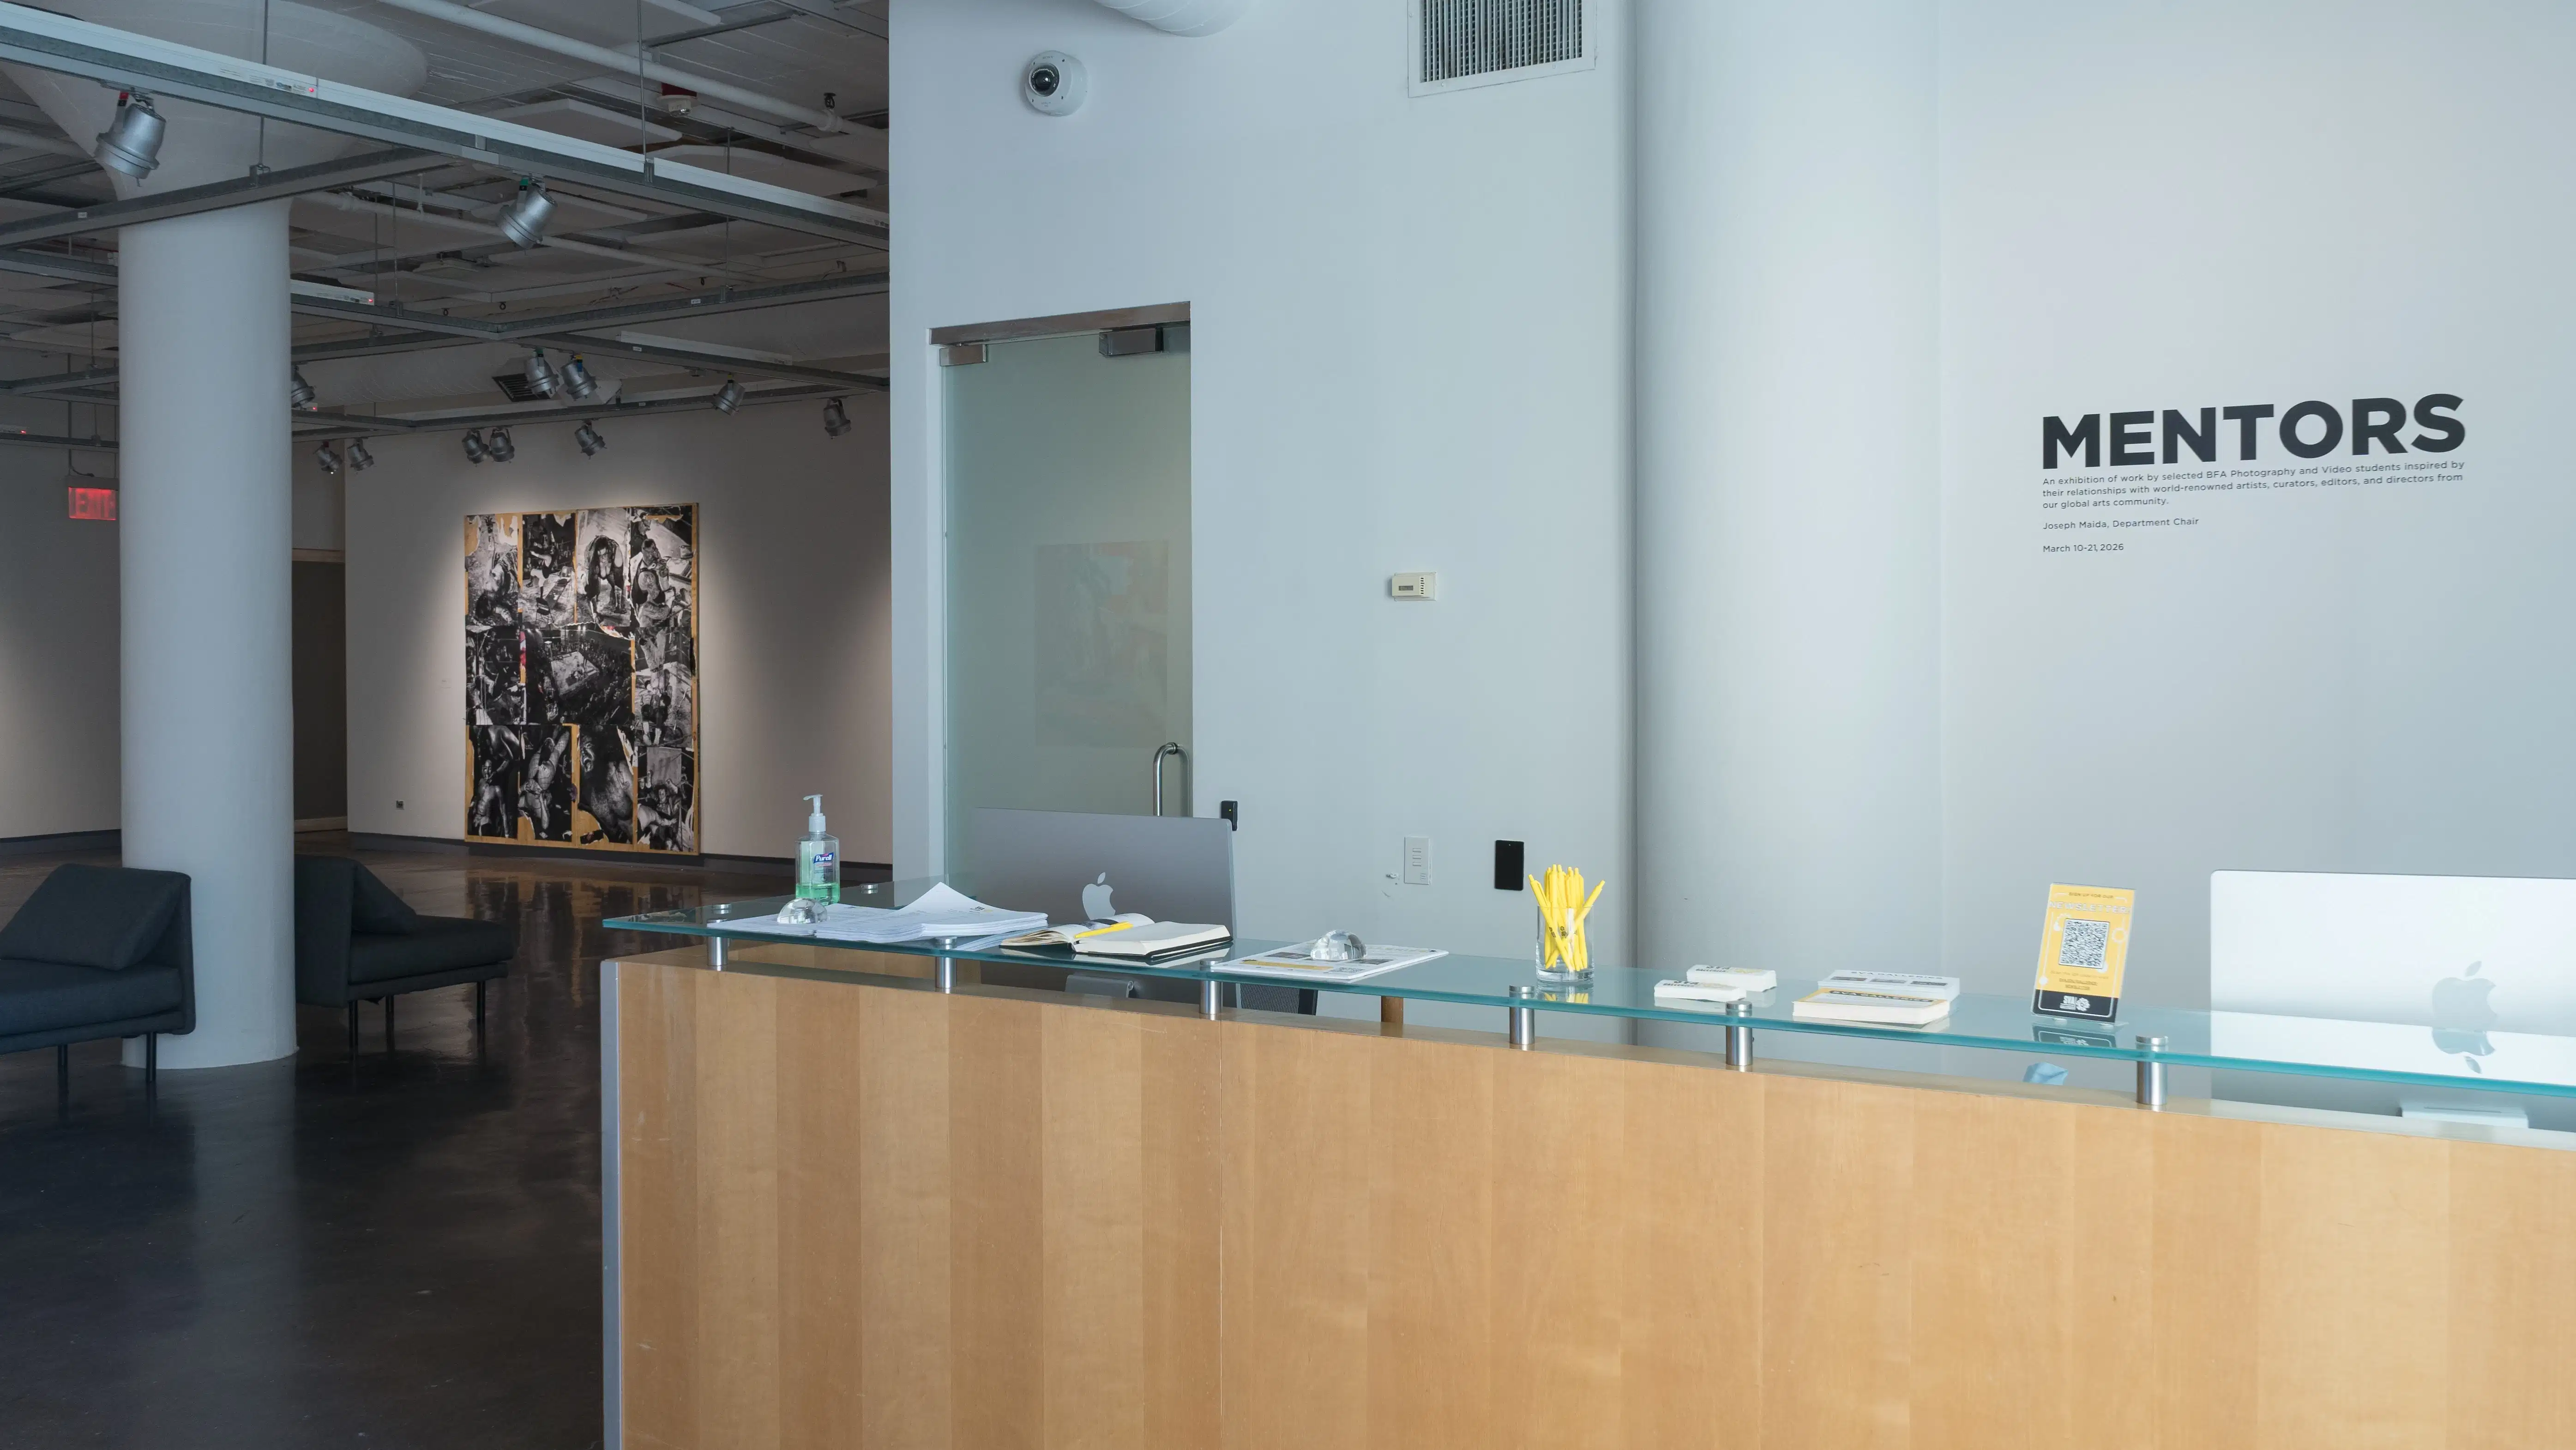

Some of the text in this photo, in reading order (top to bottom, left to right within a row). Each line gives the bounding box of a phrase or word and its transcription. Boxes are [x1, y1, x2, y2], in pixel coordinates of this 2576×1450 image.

[2042, 393, 2466, 469] MENTORS
[2058, 476, 2104, 484] exhibition
[2147, 473, 2159, 482] by
[2162, 471, 2203, 480] selected
[2231, 468, 2296, 477] Photography
[2299, 466, 2318, 475] and
[2355, 464, 2401, 472] students
[2404, 461, 2447, 471] inspired
[2451, 460, 2465, 470] by
[2067, 487, 2126, 496] relationships
[2153, 482, 2233, 493] world-renowned
[2273, 479, 2318, 488] curators,
[2363, 476, 2383, 484] and
[2386, 475, 2434, 483] directors
[2061, 500, 2089, 509] global
[2113, 496, 2169, 506] community.
[2043, 521, 2076, 530] Joseph
[2113, 519, 2170, 528] Department
[2173, 517, 2199, 526] Chair
[2073, 544, 2098, 552] 10-21,
